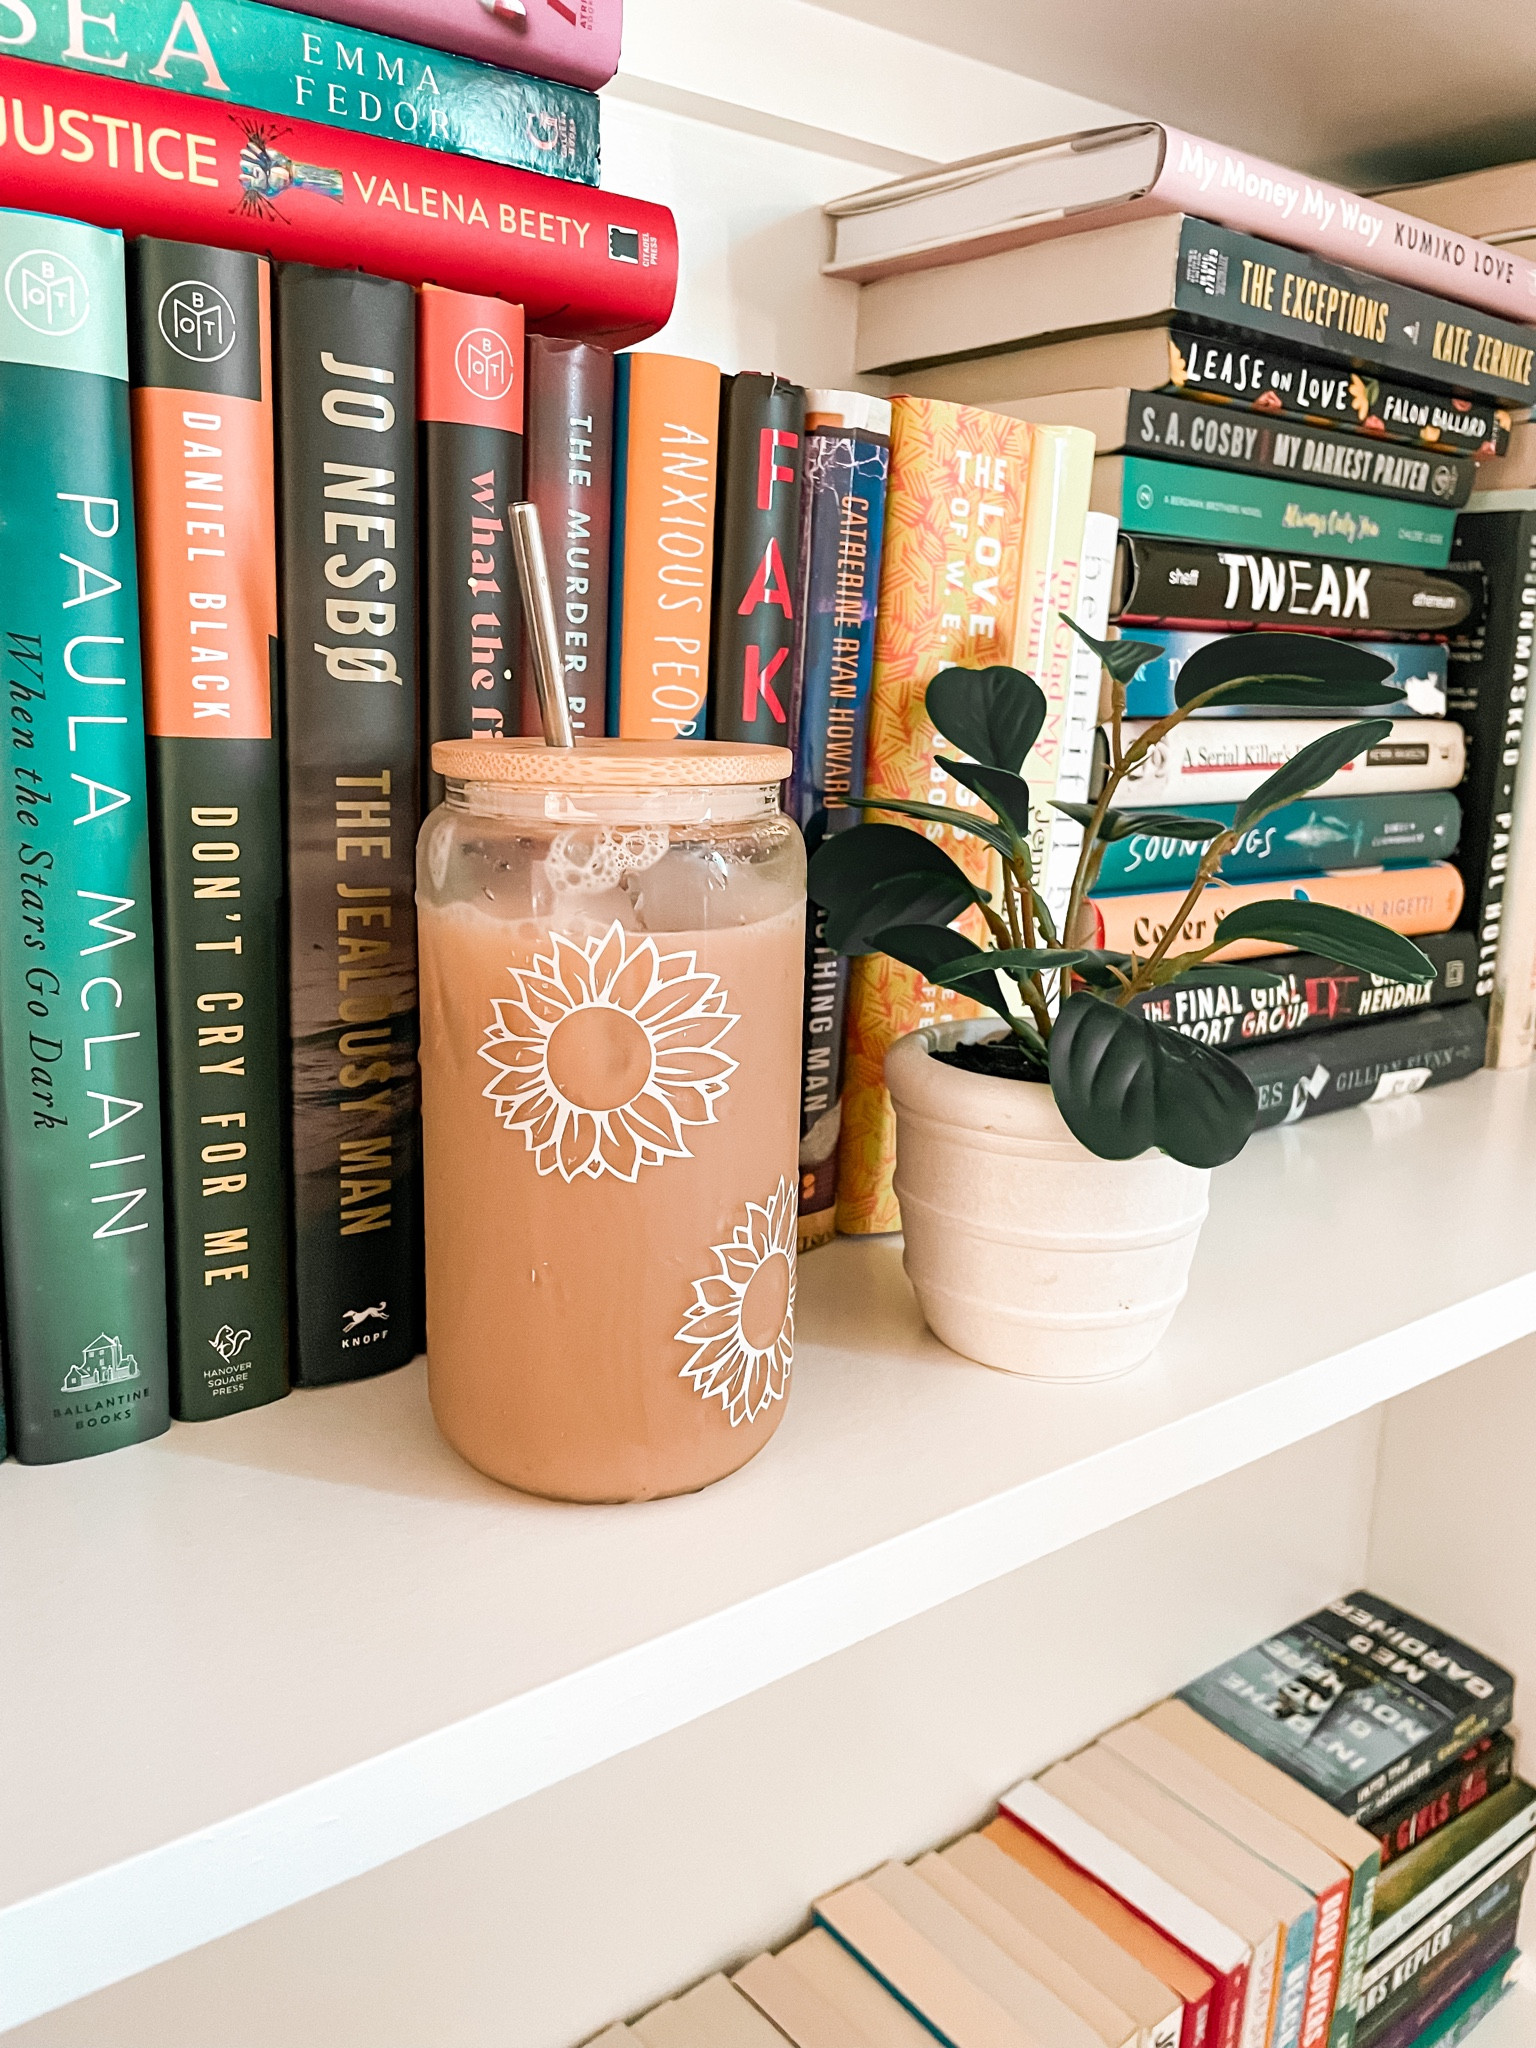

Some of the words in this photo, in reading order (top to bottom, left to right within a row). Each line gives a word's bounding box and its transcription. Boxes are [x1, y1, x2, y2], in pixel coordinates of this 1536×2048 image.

[301, 32, 441, 96] EMMA
[294, 75, 451, 140] FEDOR
[351, 171, 490, 229] VALENA
[499, 202, 591, 249] BEETY
[1178, 140, 1219, 192] My
[1221, 156, 1300, 219] Money
[1302, 184, 1336, 231] My
[1340, 197, 1384, 248] Way
[1394, 222, 1466, 266] KUMIKO
[1474, 251, 1514, 284] LOVE
[1240, 259, 1277, 311] THE
[1281, 273, 1390, 344] EXCEPTIONS
[1187, 342, 1266, 392] LEASE
[1270, 370, 1293, 392] ON
[1296, 368, 1349, 411] LOVE
[1432, 320, 1473, 368] KATE
[1473, 333, 1536, 386] ZERNIKE
[320, 351, 396, 433] JO
[1383, 395, 1430, 427] FALON
[1431, 406, 1487, 438] BALLARD
[567, 415, 593, 486] THE
[1140, 406, 1161, 443] S.
[1164, 411, 1186, 448] A.
[1190, 415, 1258, 461] COSBY
[1272, 432, 1302, 469] MY
[1302, 438, 1374, 482] DARKEST
[1372, 453, 1431, 492] PRAYER
[182, 410, 226, 562] DANIEL
[955, 449, 1008, 492] THE
[658, 421, 710, 614] ANXIOUS
[950, 497, 970, 540] OF
[313, 461, 403, 686] NESBØ
[564, 508, 592, 673] MURDER
[834, 495, 870, 630] CATHERINE
[943, 559, 965, 596] W.
[968, 502, 1005, 639] LOVE
[1058, 559, 1078, 611] I'm
[1168, 567, 1200, 587] sheff
[1216, 551, 1372, 620] TWEAK
[56, 492, 132, 826] PAULA
[188, 591, 231, 720] BLACK
[471, 611, 505, 692] the
[940, 613, 961, 643] E.
[1048, 617, 1073, 701] Glad
[6, 632, 46, 748] When
[831, 636, 861, 700] RYAN
[823, 704, 857, 811] HOWARD
[1033, 713, 1061, 765] My
[1183, 746, 1194, 767] A
[1199, 744, 1240, 767] Serial
[12, 752, 50, 826] the
[335, 769, 392, 862] THE
[190, 806, 242, 955] DON'T
[1487, 811, 1513, 890] PAUL
[18, 842, 55, 956] Stars
[1133, 916, 1207, 948] Coer
[1382, 896, 1434, 917] RIGETTI
[1475, 902, 1503, 998] HOLES
[24, 966, 62, 1019] Go
[336, 882, 393, 1113] JEALOUSY
[1142, 999, 1172, 1023] THE
[1175, 984, 1244, 1024] FINAL
[1250, 973, 1303, 1011] GIRL
[1240, 1001, 1309, 1039] GROUP
[1357, 977, 1434, 1016] HENDRIX
[195, 991, 246, 1078] CRY
[28, 1030, 70, 1130] Dark
[804, 1045, 831, 1113] MAN
[199, 1112, 248, 1198] FOR
[339, 1135, 392, 1236] MAN
[203, 1226, 249, 1287] ME
[203, 1360, 253, 1379] HANOVER
[341, 1329, 389, 1349] KNOPF
[53, 1386, 150, 1419] BALLANTINE
[207, 1371, 249, 1389] SQUARE
[212, 1382, 245, 1397] PRESS
[75, 1408, 132, 1430] BOOKS
[1314, 1890, 1344, 1963] BOOK
[1391, 1923, 1453, 1991] KEPLER
[1302, 1959, 1334, 2048] LOVERS
